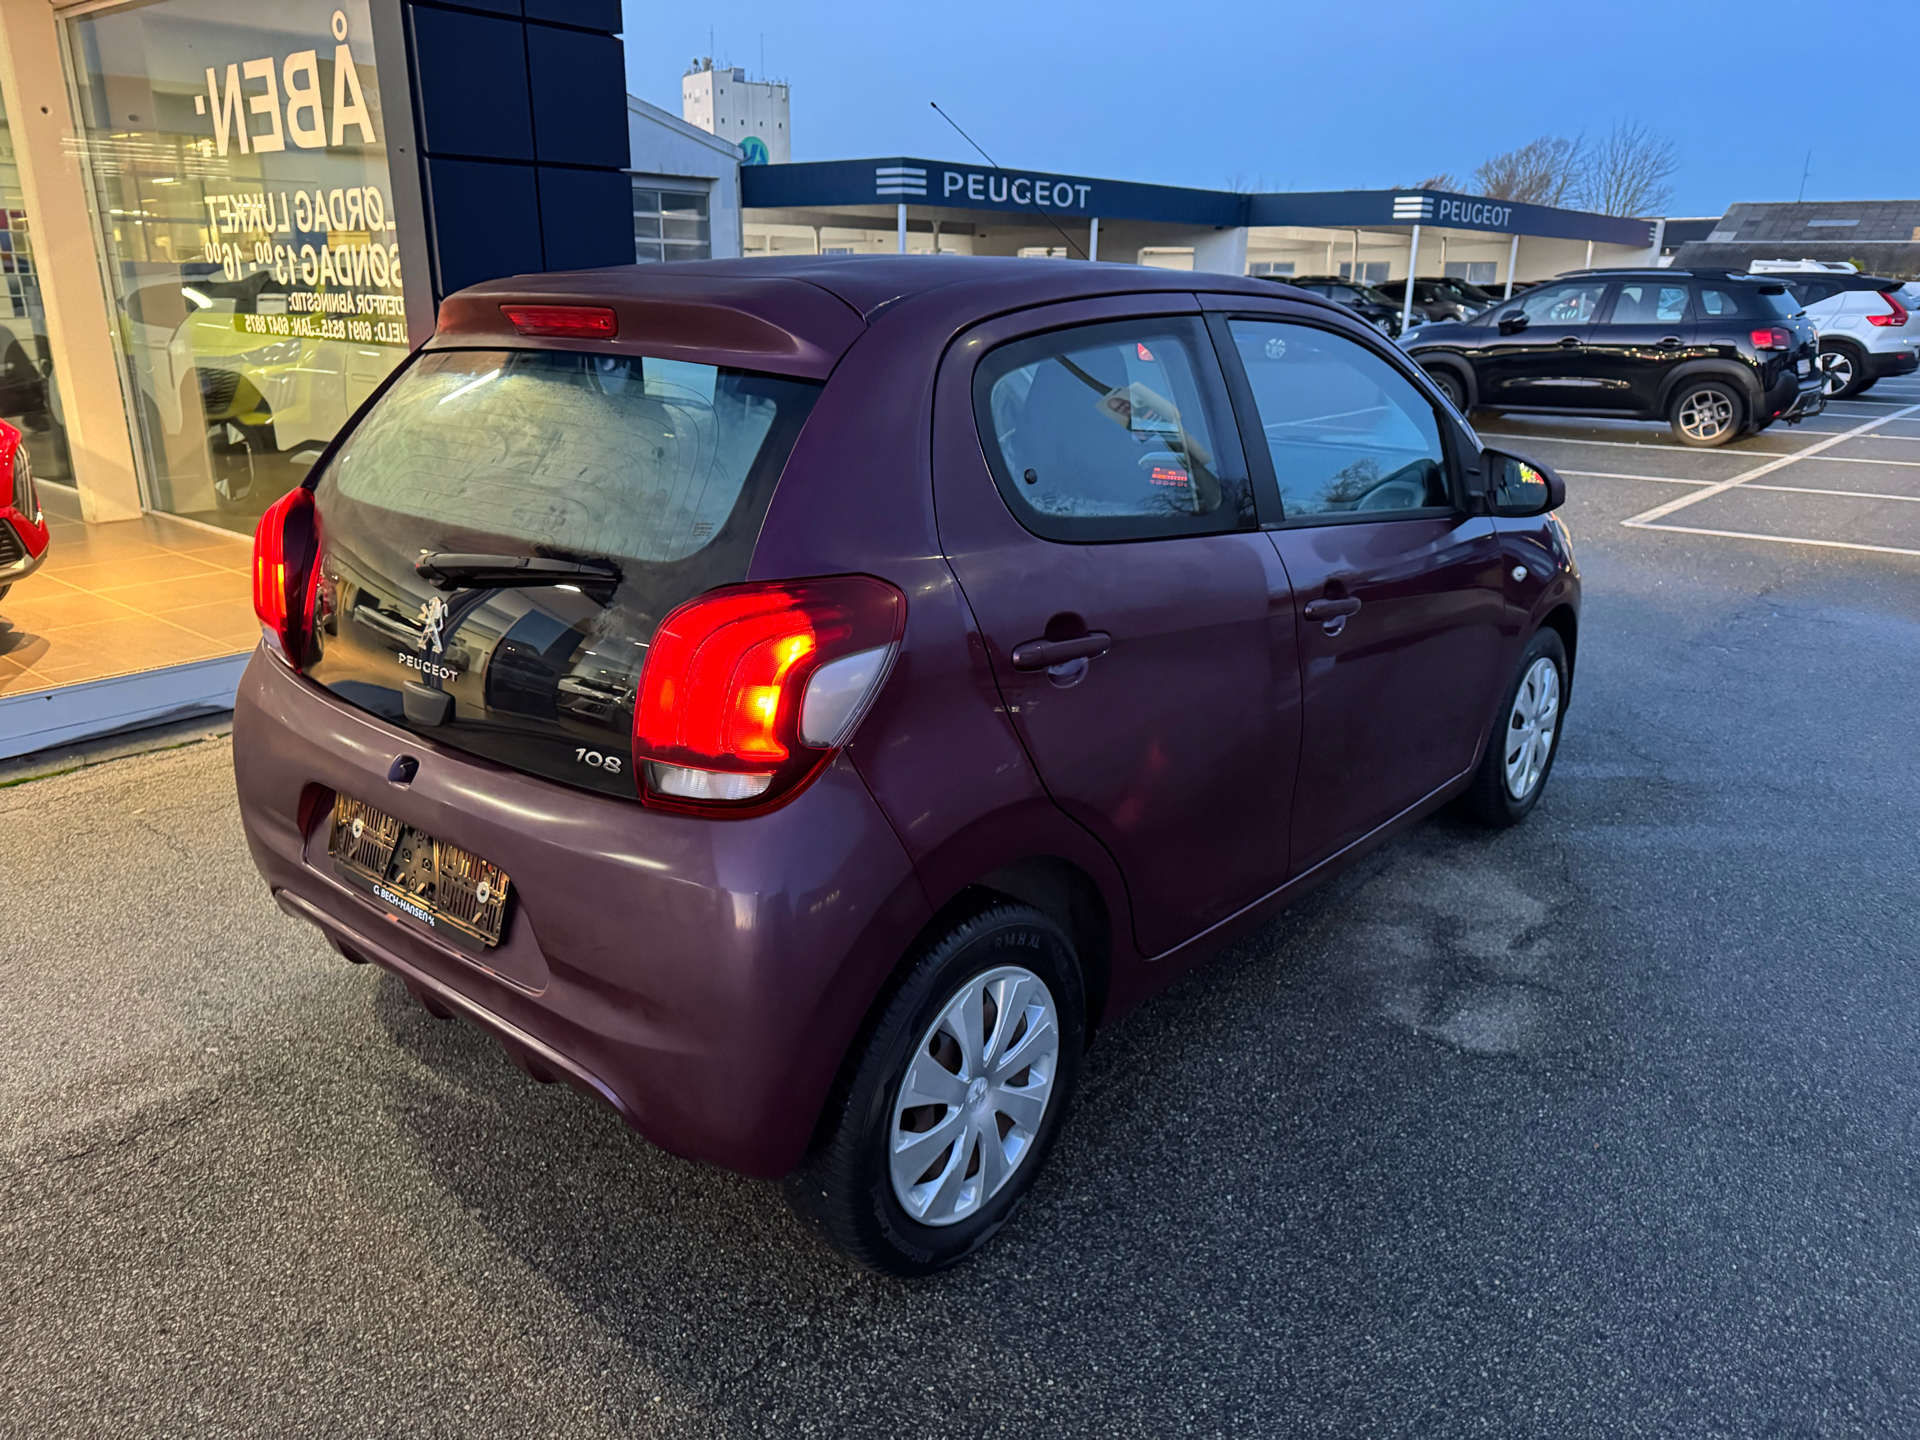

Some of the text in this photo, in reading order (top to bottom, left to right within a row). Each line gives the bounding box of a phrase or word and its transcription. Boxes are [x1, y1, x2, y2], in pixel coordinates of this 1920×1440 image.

[943, 171, 1092, 209] PEUGEOT
[1439, 199, 1512, 227] PEUGEOT
[397, 652, 459, 683] PEUGEOT
[575, 747, 622, 775] 108
[380, 888, 428, 923] BECH-HANSEN
